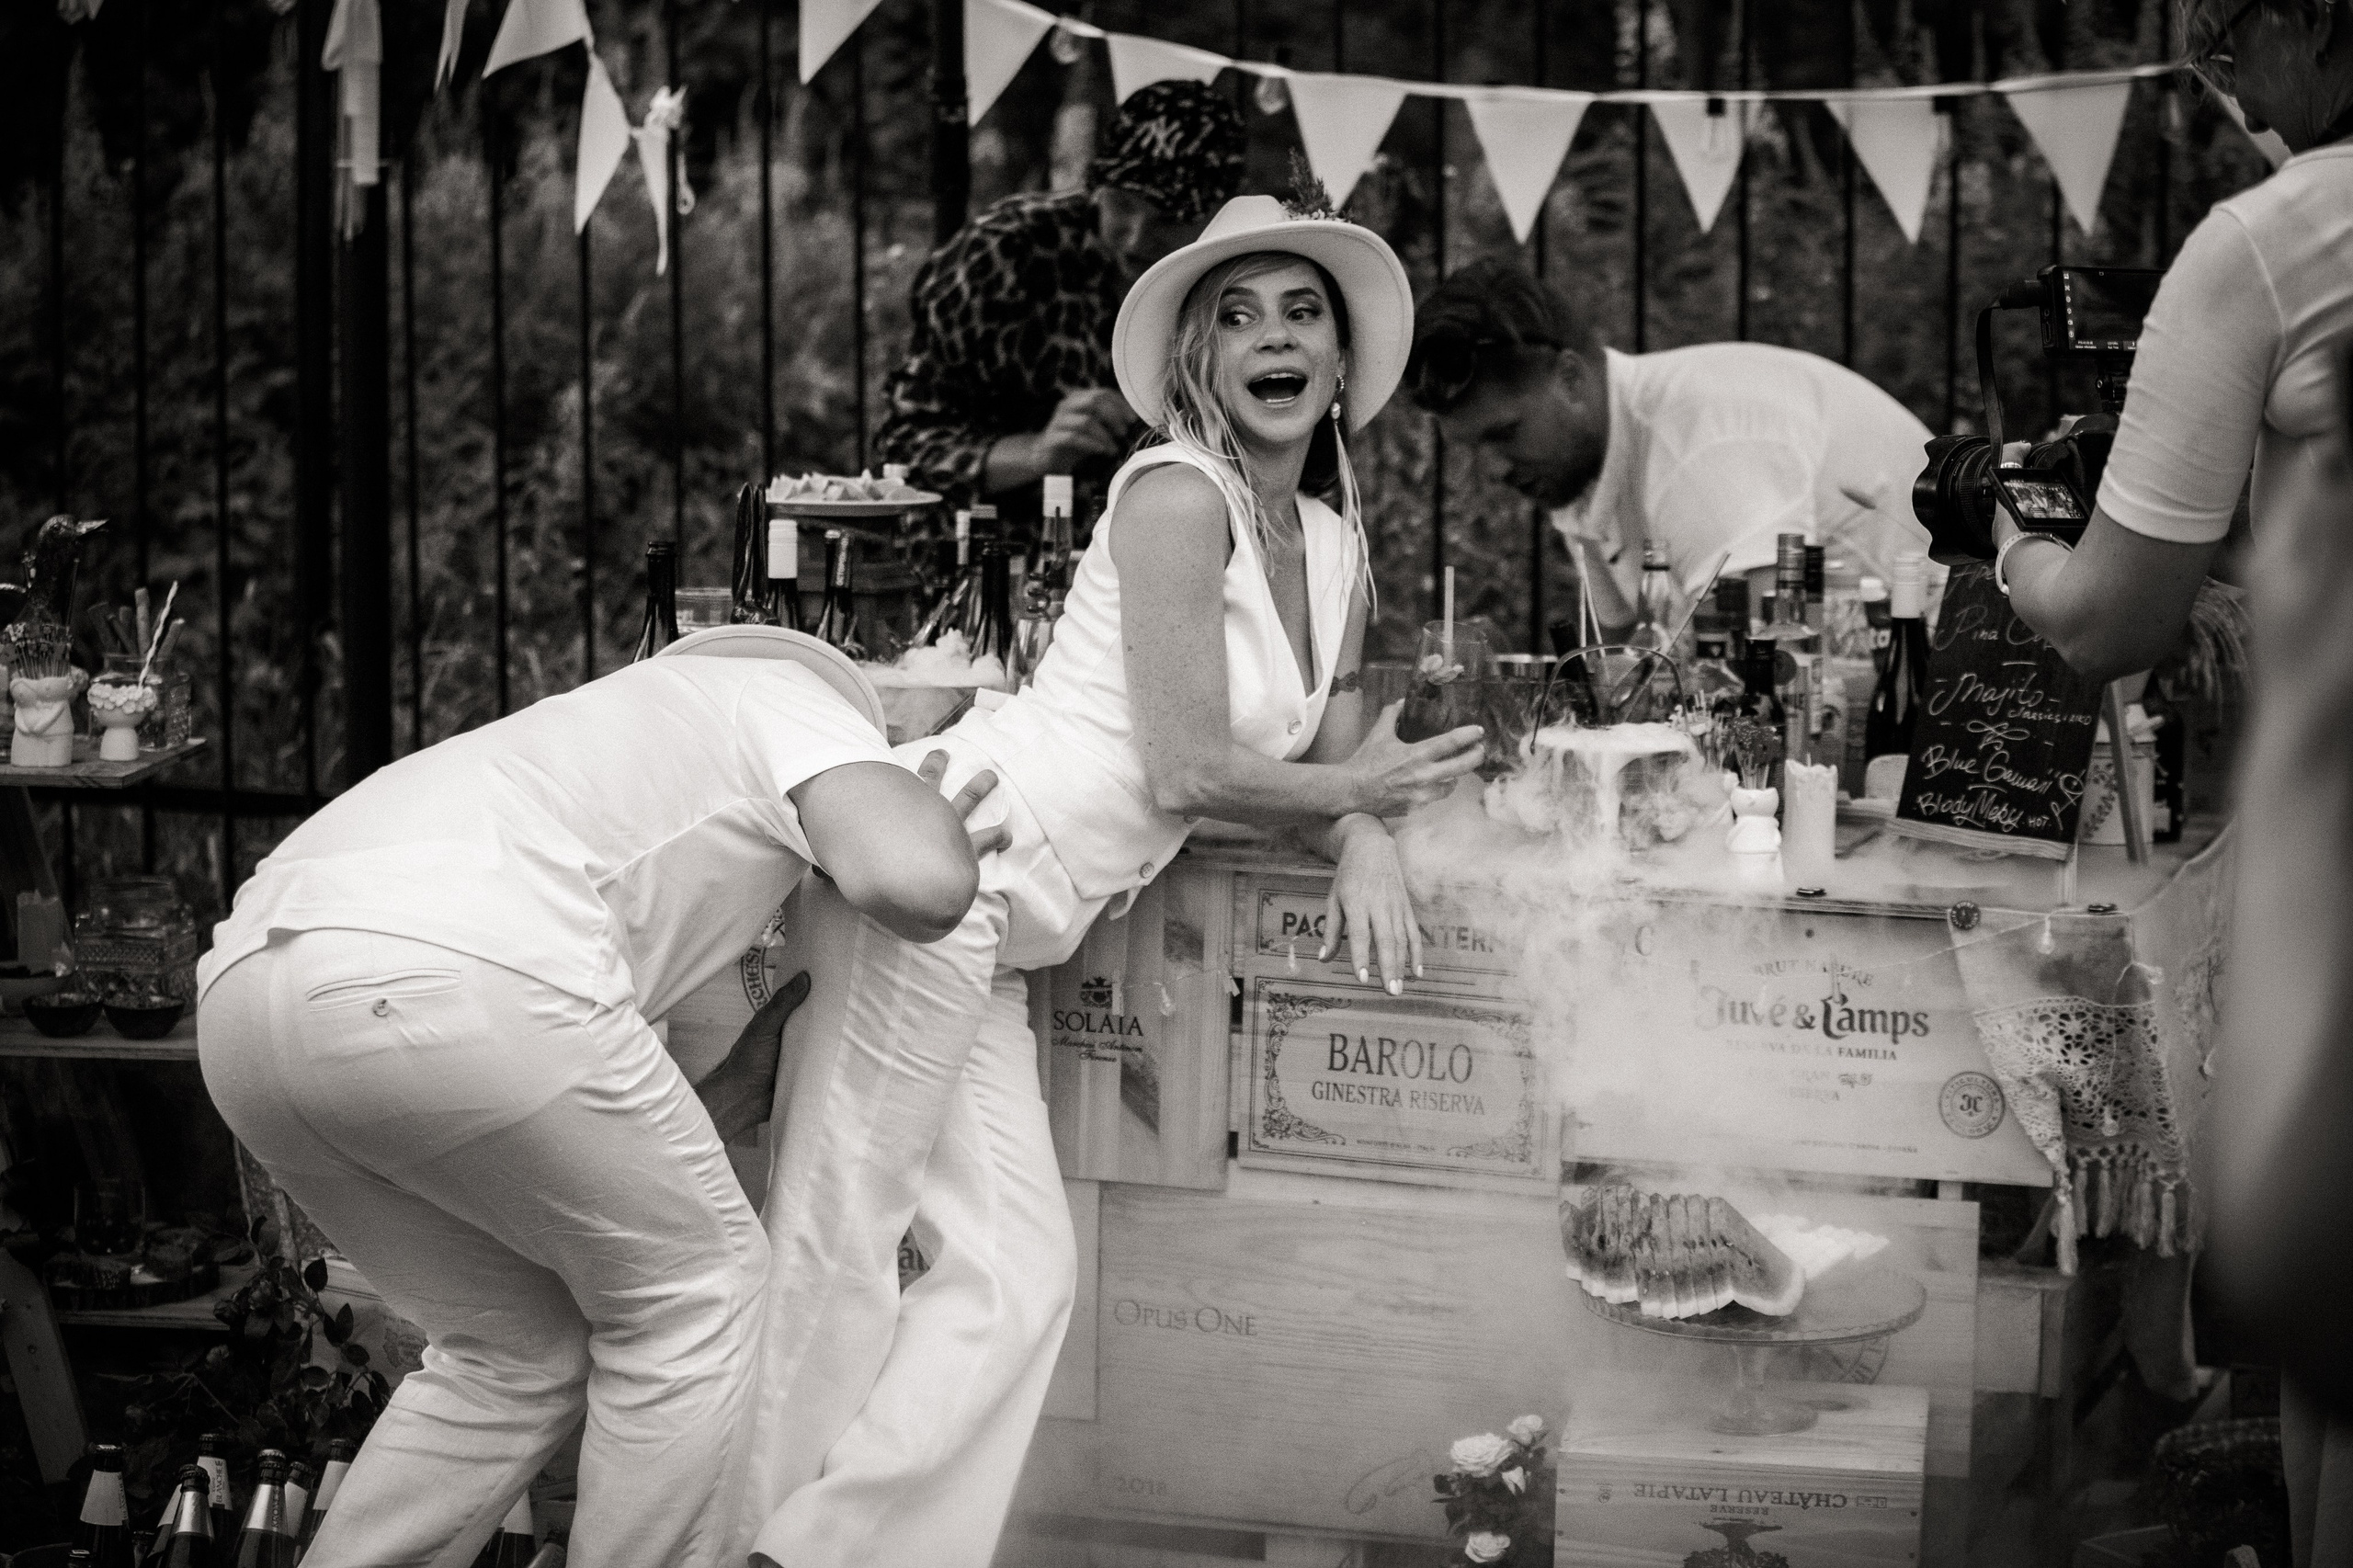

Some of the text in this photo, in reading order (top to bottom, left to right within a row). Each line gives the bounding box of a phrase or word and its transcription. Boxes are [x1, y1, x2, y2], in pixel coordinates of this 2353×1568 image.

[1921, 744, 1981, 780] Blue
[1052, 1010, 1143, 1037] SOLAIA
[1793, 1003, 1816, 1030] &
[1327, 1032, 1472, 1085] BAROLO
[1837, 1046, 1898, 1062] FAMILIA
[1311, 1080, 1486, 1116] GINESTRA RISERVA
[1633, 1483, 1729, 1503] LATAPIE
[1738, 1488, 1848, 1511] CHÂTEAU
